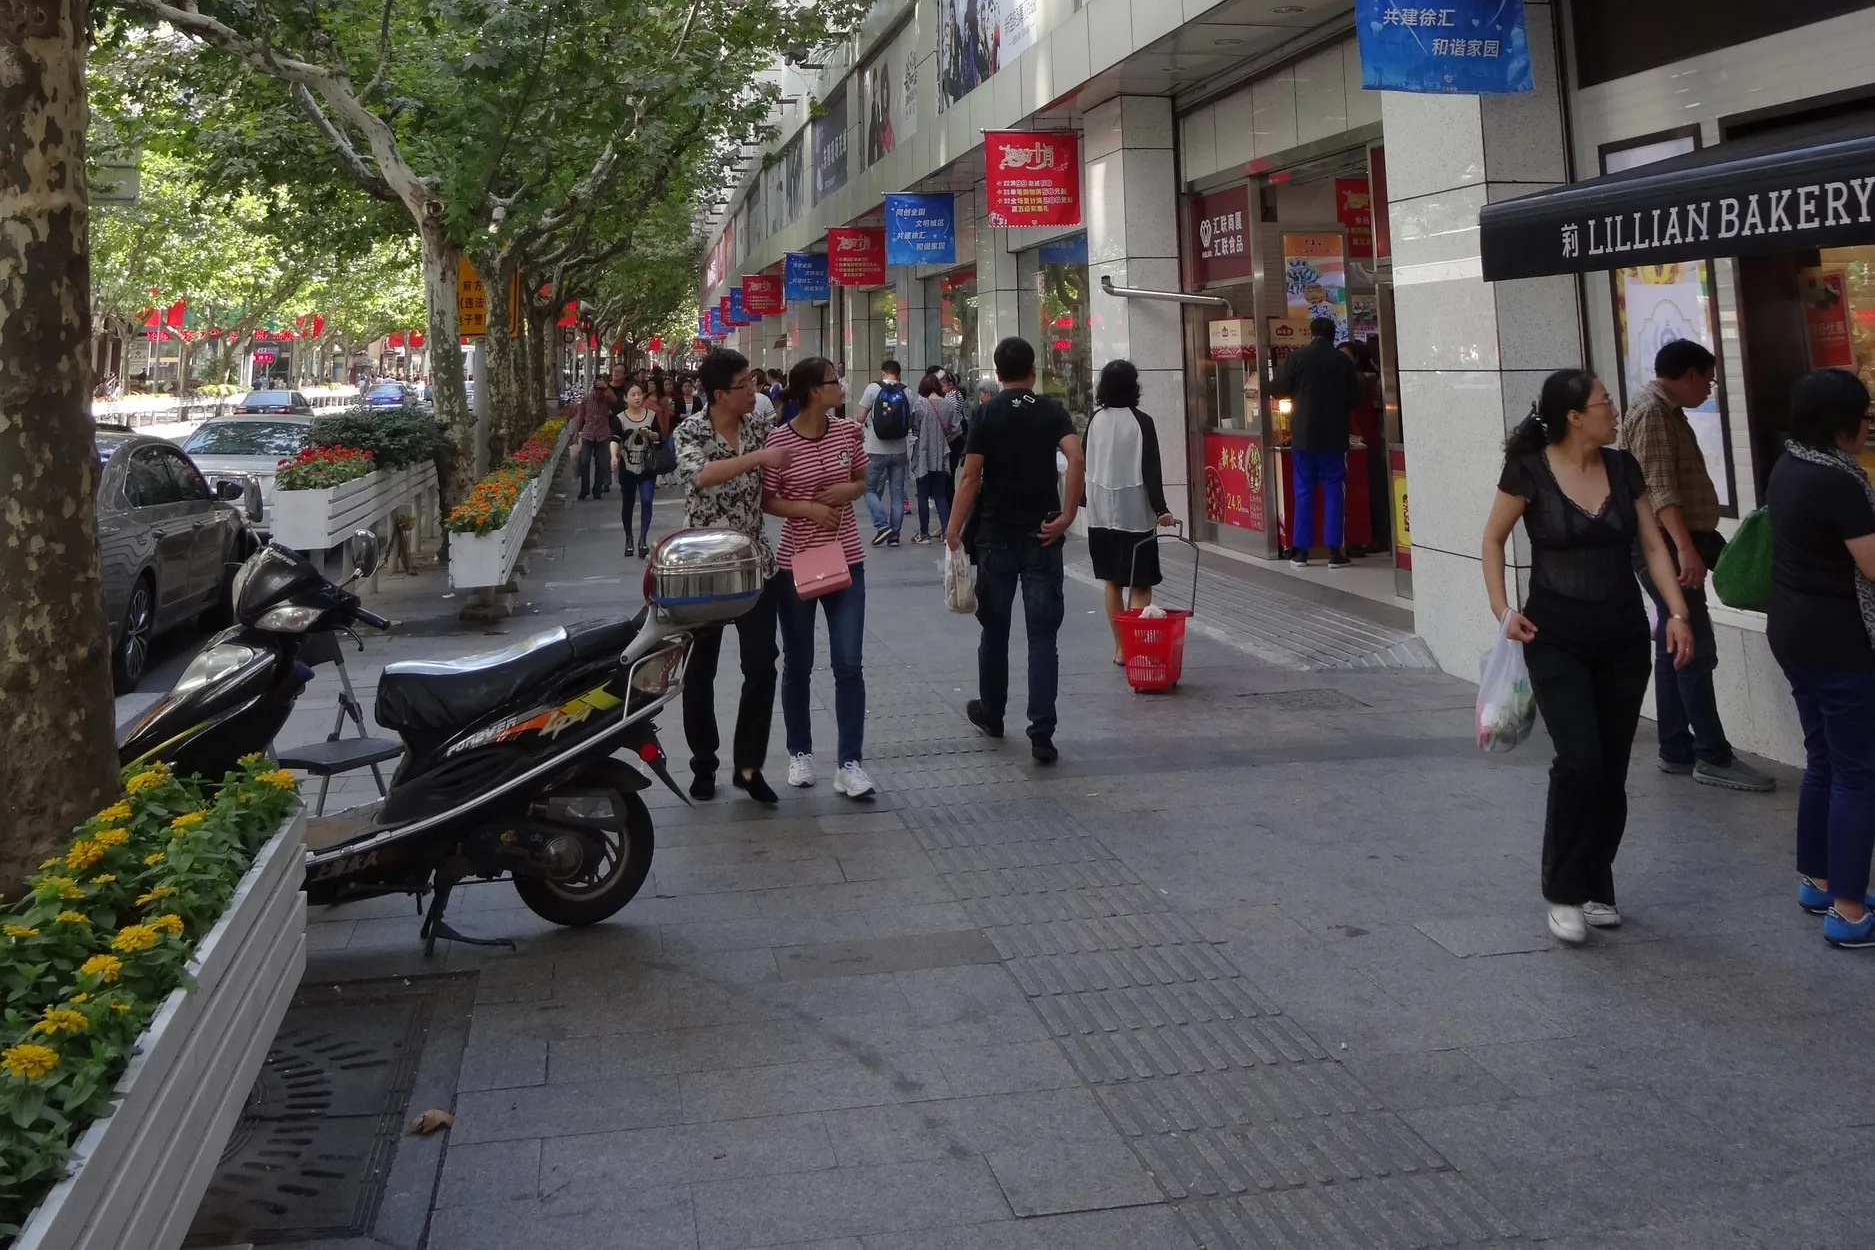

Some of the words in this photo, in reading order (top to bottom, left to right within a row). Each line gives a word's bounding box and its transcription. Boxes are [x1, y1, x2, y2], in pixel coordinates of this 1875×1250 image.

[1382, 7, 1456, 27] 共建徐汇
[1431, 38, 1500, 58] 和谐家园
[1213, 211, 1242, 234] 汇联商厦
[1588, 201, 1711, 256] LILLIAN
[1718, 176, 1875, 239] BAKERY
[1214, 235, 1244, 257] 汇联食品
[463, 280, 483, 292] 前方
